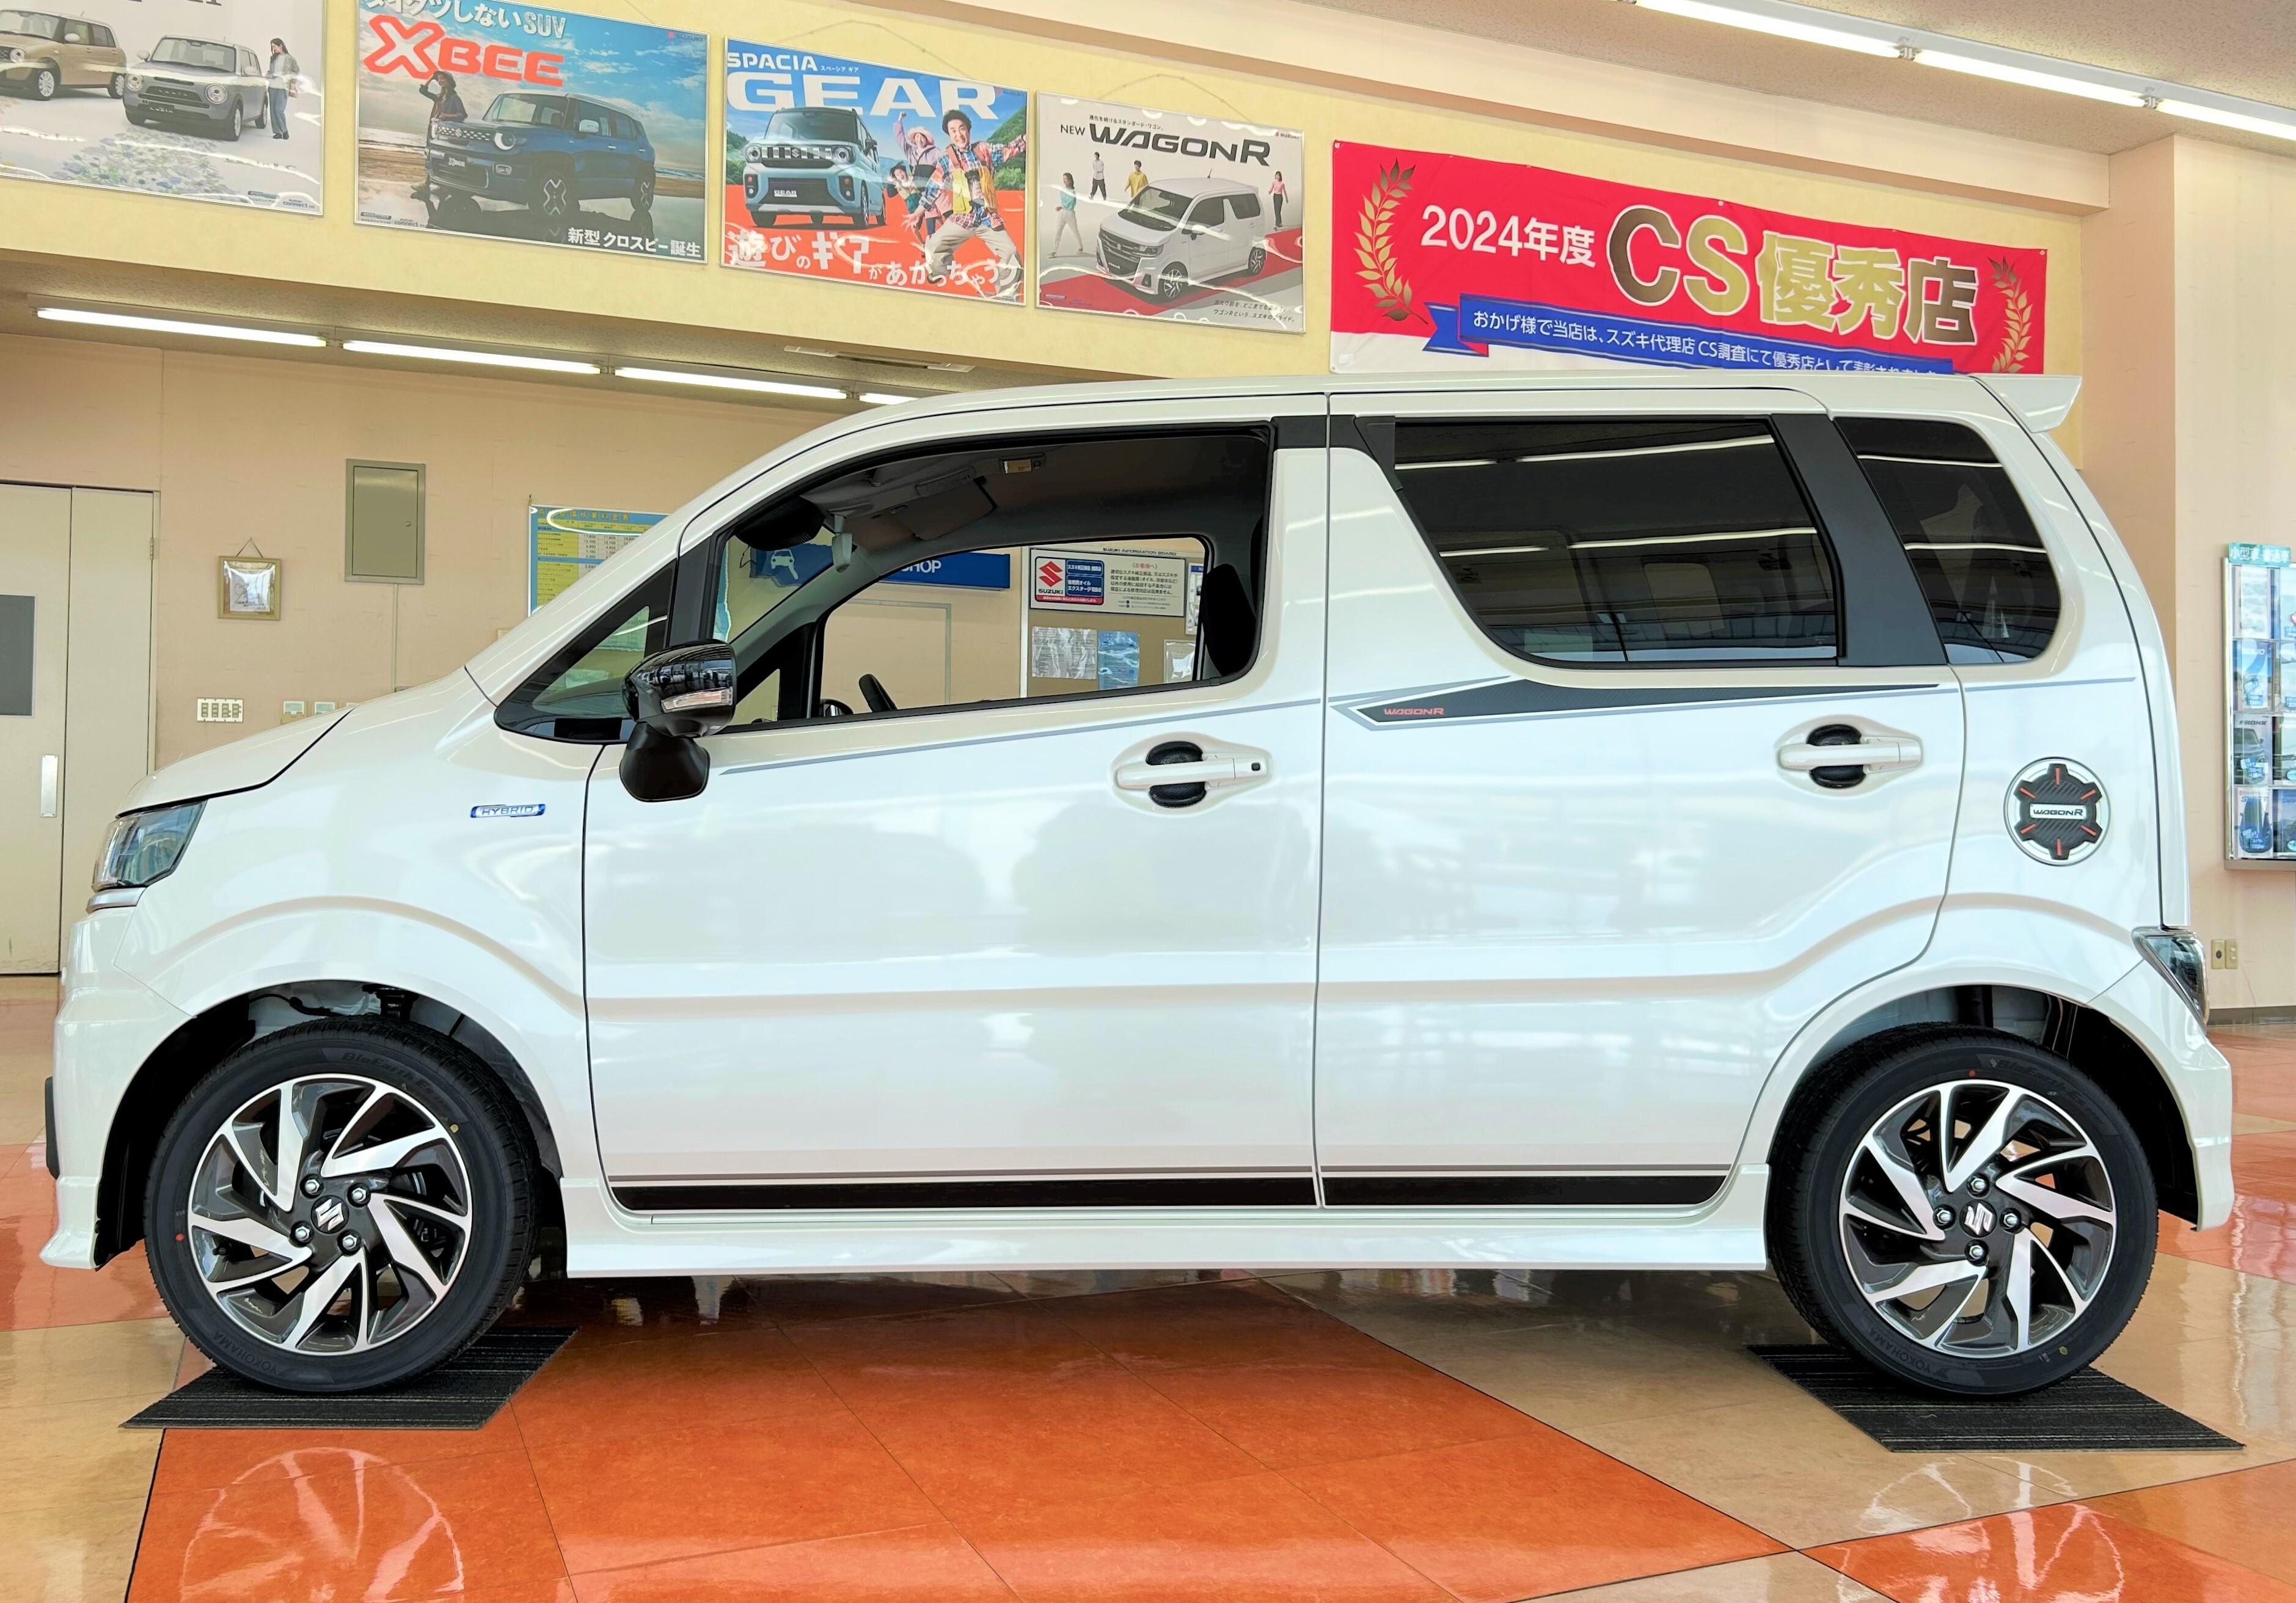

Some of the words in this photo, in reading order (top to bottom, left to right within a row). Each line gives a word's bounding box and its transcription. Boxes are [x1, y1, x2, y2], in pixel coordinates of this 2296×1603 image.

[364, 15, 564, 87] XBEE
[727, 53, 818, 71] SPACIA
[727, 71, 999, 120] GEAR
[1061, 124, 1086, 136] NEW
[1420, 204, 1596, 268] 2024年度
[1606, 204, 1979, 346] CS優秀店
[901, 560, 942, 573] HOP
[481, 806, 533, 816] HYBRID
[214, 1330, 277, 1374] YOKOHAMA
[1868, 1327, 1931, 1373] YOKOHAMA
